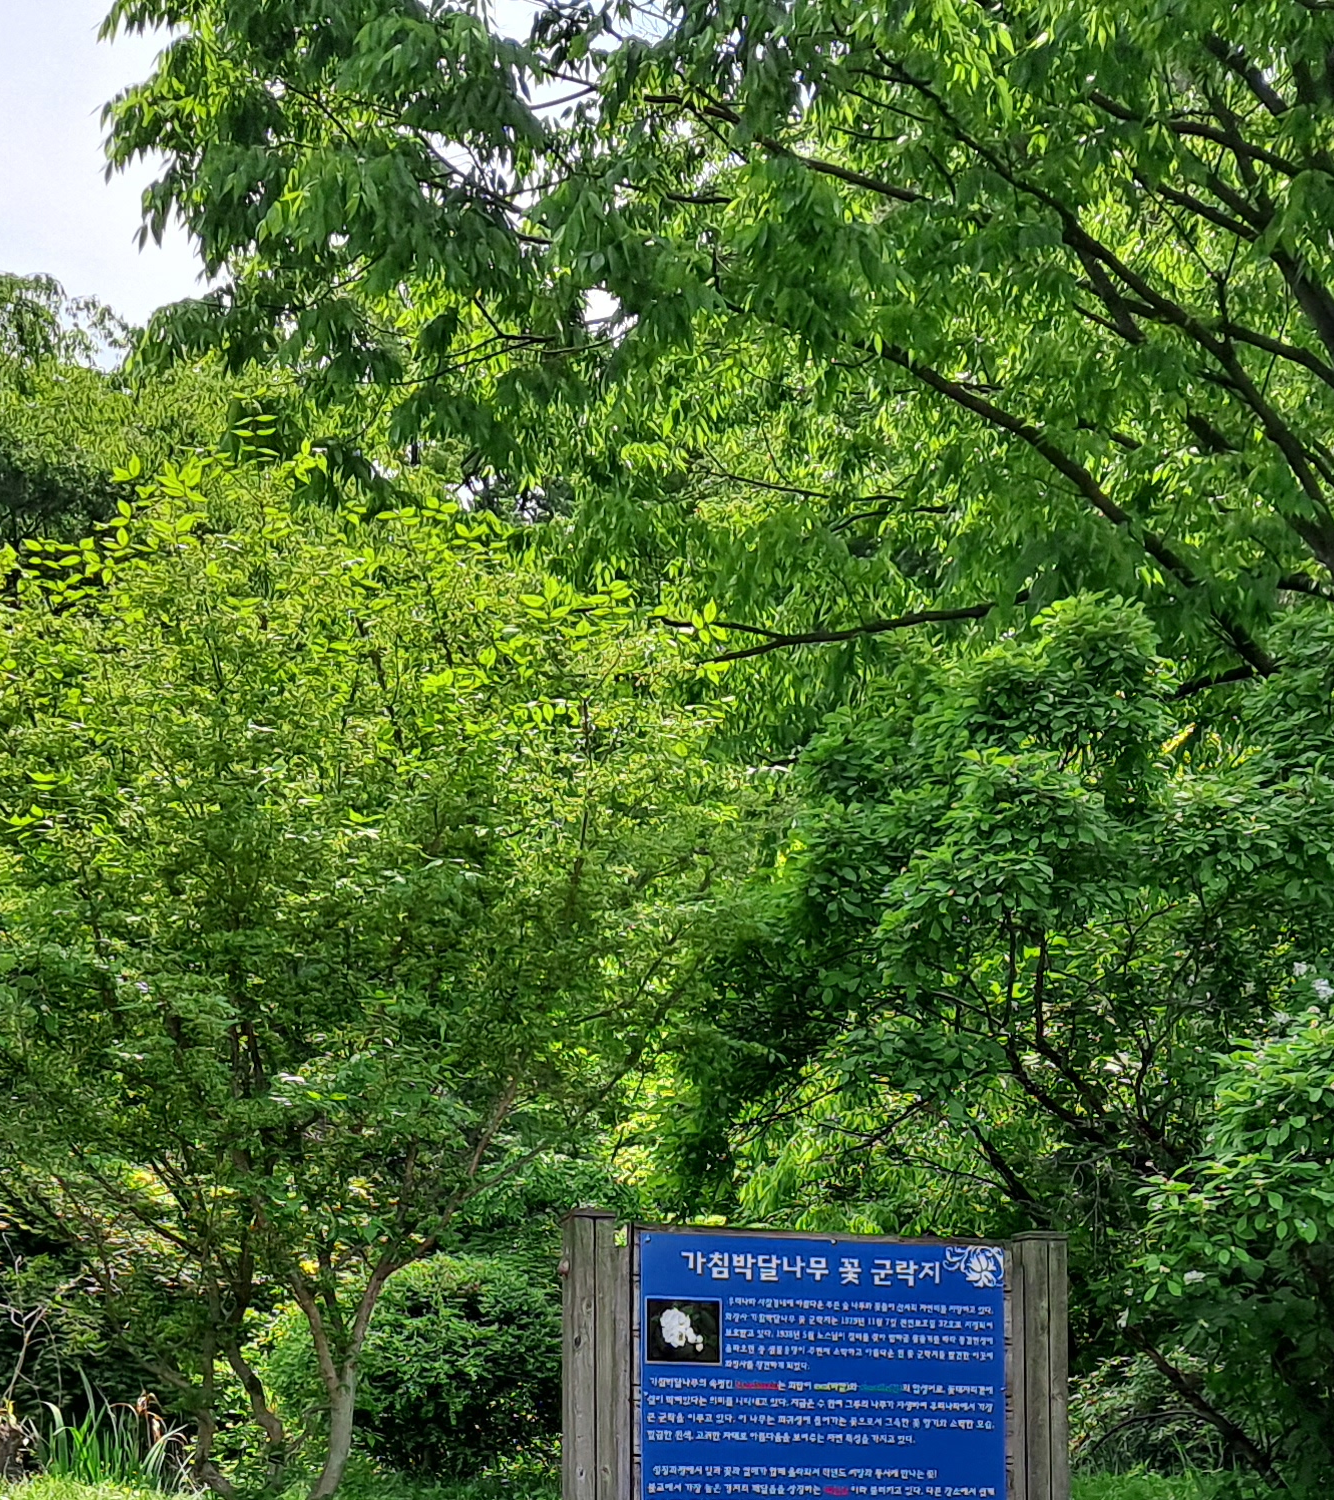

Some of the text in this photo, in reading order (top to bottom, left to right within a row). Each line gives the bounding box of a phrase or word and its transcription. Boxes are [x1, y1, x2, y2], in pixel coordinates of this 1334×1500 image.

[680, 1251, 940, 1287] 가침박달나무 꽃 군락지
